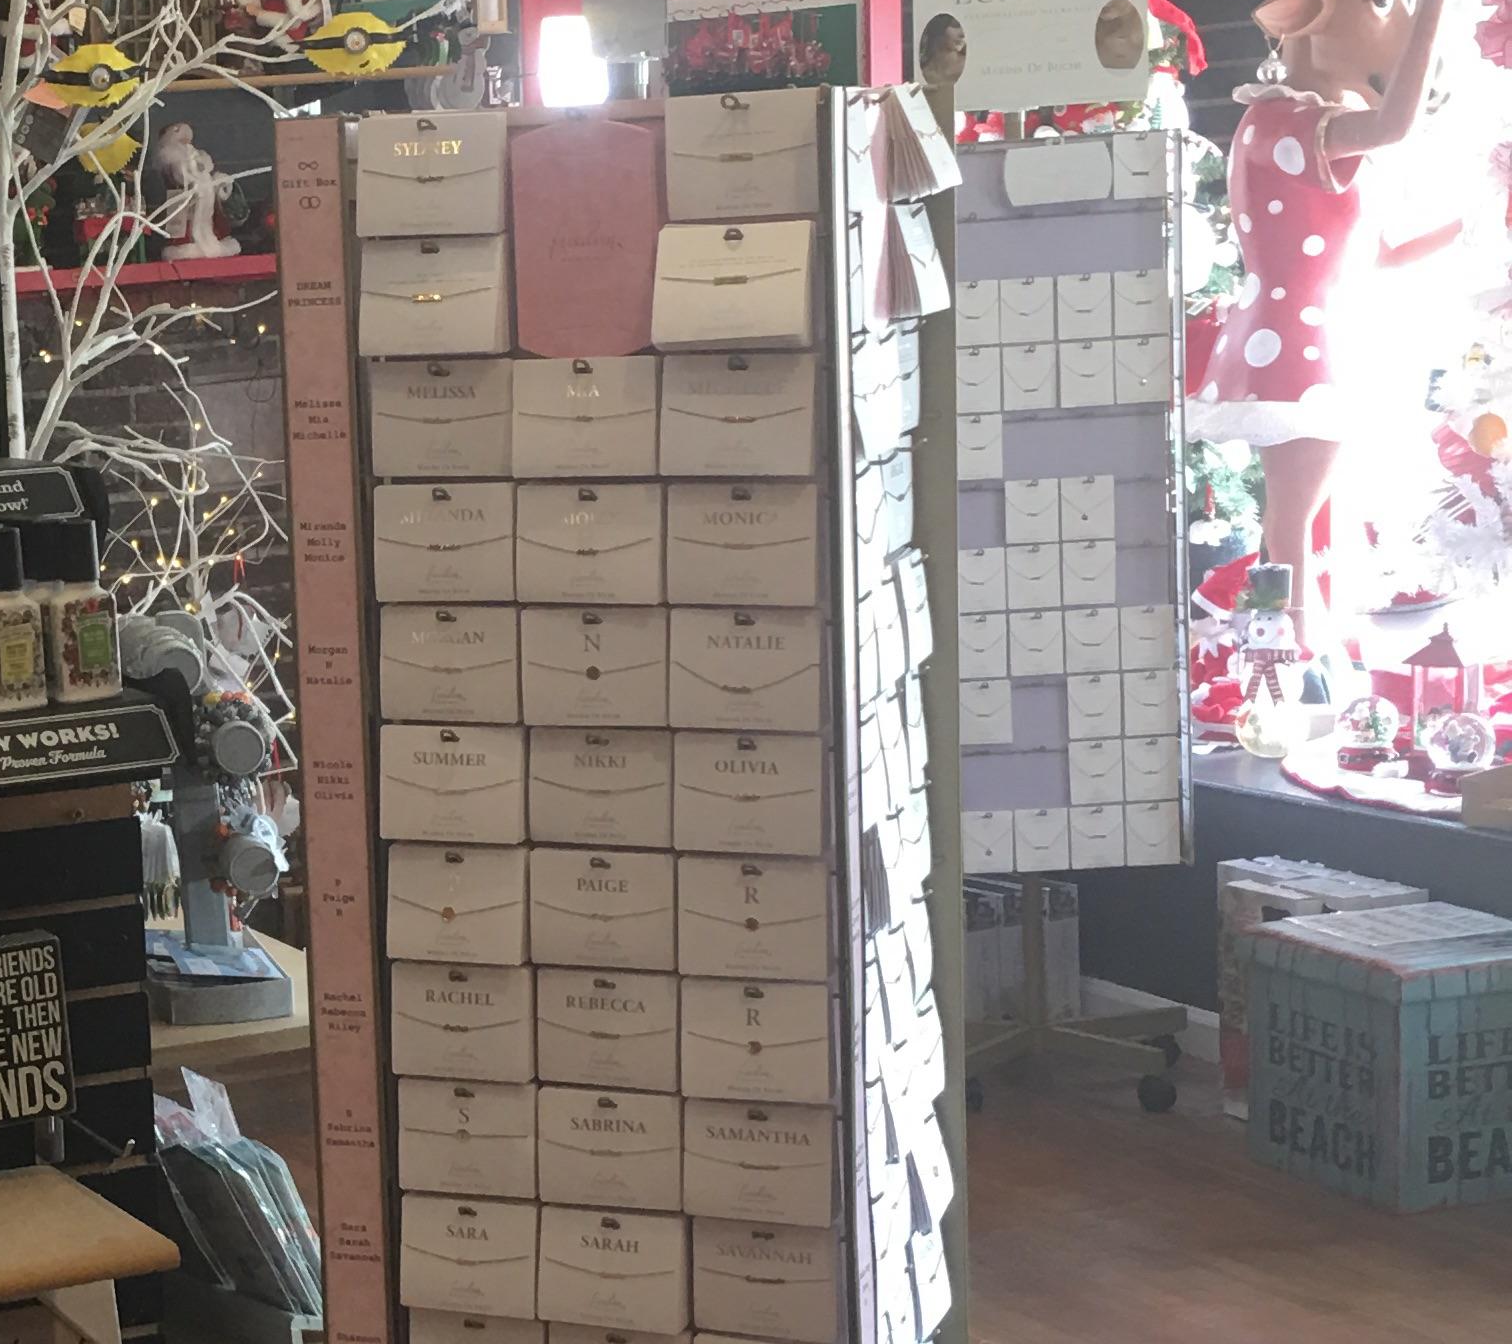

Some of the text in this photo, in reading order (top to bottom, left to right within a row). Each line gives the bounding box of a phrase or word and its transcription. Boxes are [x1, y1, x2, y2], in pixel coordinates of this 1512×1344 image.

[316, 177, 337, 187] Box
[407, 385, 476, 400] MELISSA
[292, 429, 347, 441] Michelle
[300, 522, 347, 531] Miranda
[307, 537, 340, 548] Molly
[308, 645, 348, 657] Morgan
[583, 633, 601, 653] N
[707, 634, 786, 651] NATALIE
[306, 676, 353, 686] Natalie
[16, 722, 119, 749] WORKS!
[0, 754, 48, 771] Proven
[48, 746, 107, 765] Formula
[412, 751, 487, 767] SUMMER
[573, 754, 627, 769] NIKKI
[714, 758, 779, 776] OLIVIA
[314, 791, 354, 801] Olivia
[576, 876, 629, 894] PAIGE
[322, 893, 355, 904] Paige
[744, 885, 760, 904] R
[21, 972, 58, 1002] OLD
[324, 992, 363, 1002] Rachel
[425, 988, 495, 1007] RACHEL
[565, 995, 646, 1014] REBECCA
[13, 1000, 61, 1030] THEN
[746, 1008, 761, 1026] R
[1268, 1002, 1338, 1053] LIFE
[11, 1026, 62, 1065] NEW
[1269, 1034, 1375, 1098] BETTER
[458, 1108, 470, 1124] S
[570, 1116, 647, 1134] SABRINA
[705, 1125, 812, 1146] SAMANTHA
[1269, 1098, 1376, 1182] BEACH
[446, 1224, 489, 1241] SARA
[580, 1235, 640, 1254] SARAH
[716, 1243, 812, 1265] SAVANNAH
